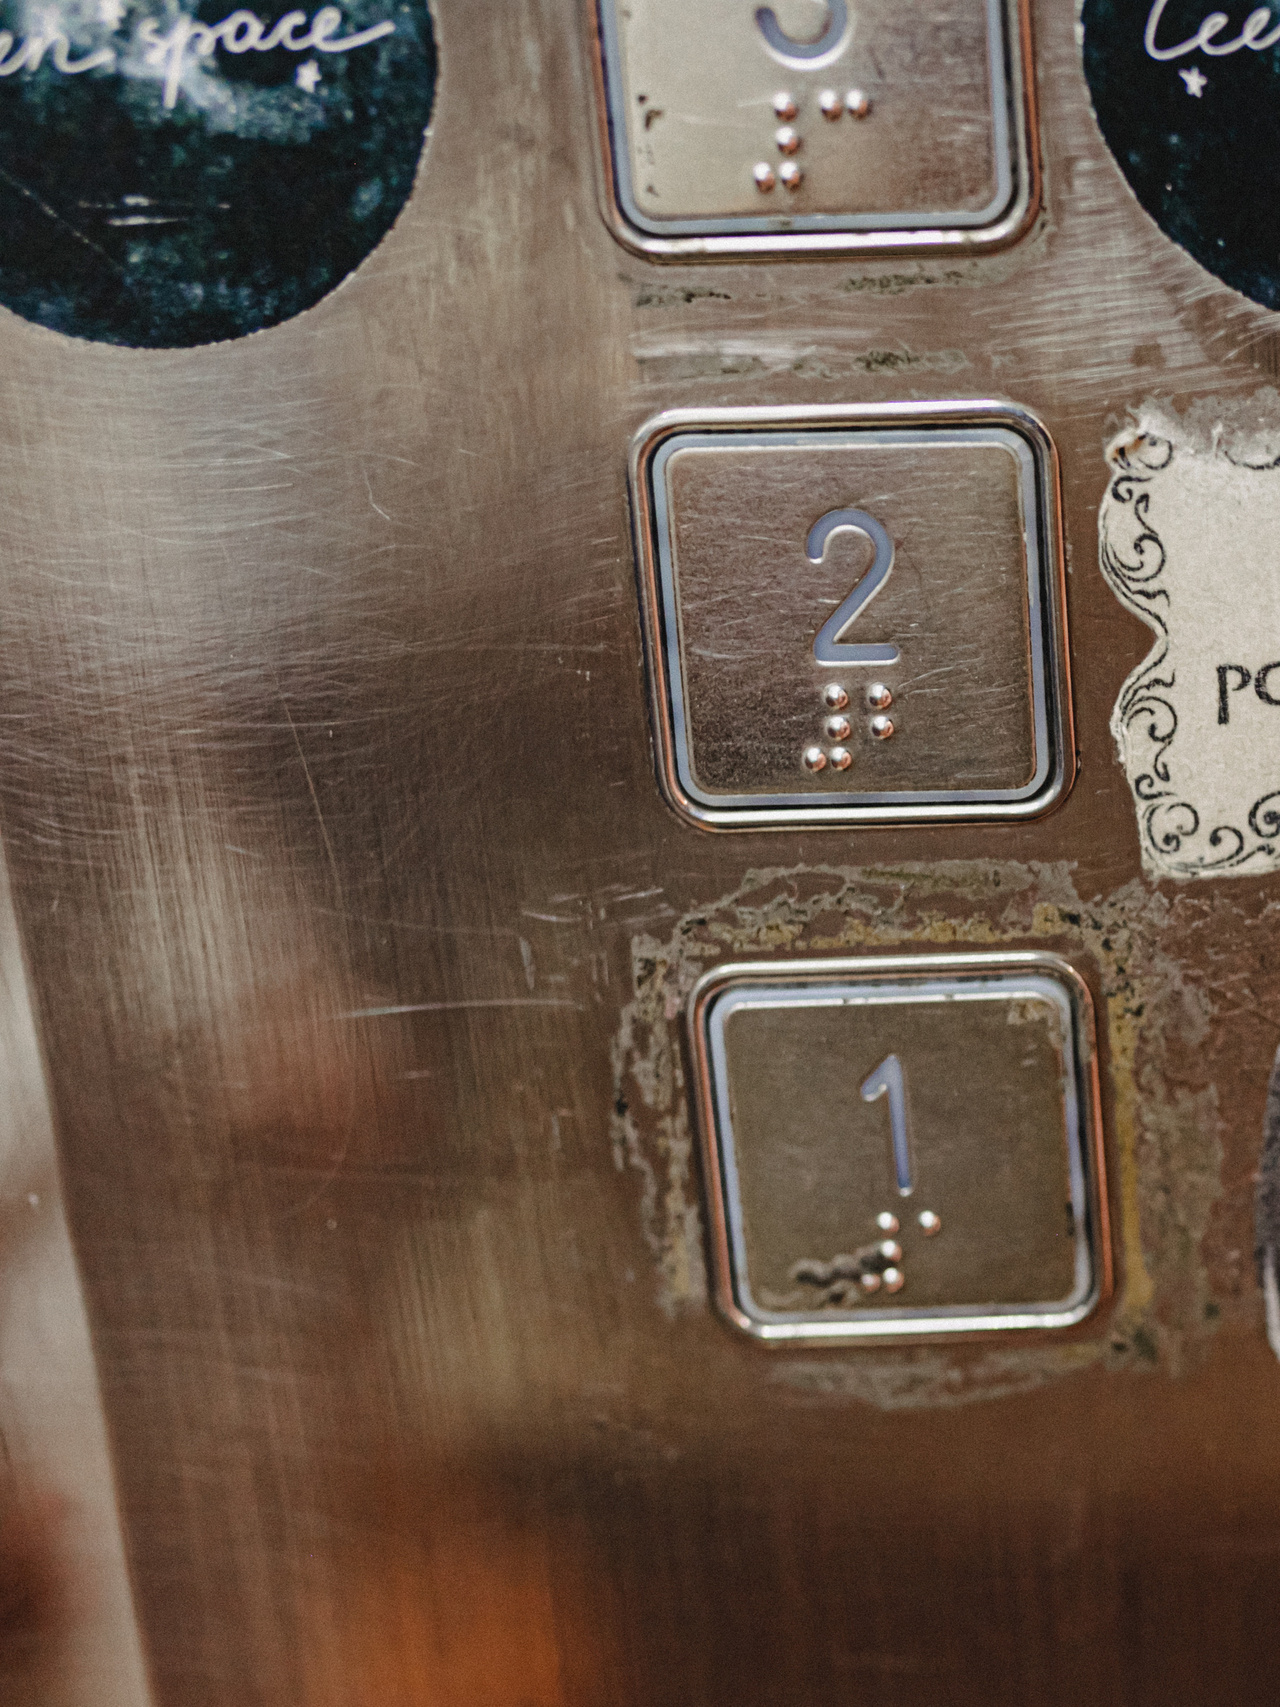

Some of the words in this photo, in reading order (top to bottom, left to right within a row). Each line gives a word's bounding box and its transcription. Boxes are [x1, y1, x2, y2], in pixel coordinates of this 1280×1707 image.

[137, 6, 396, 109] space
[806, 507, 900, 667] 2
[860, 1053, 914, 1198] 1
